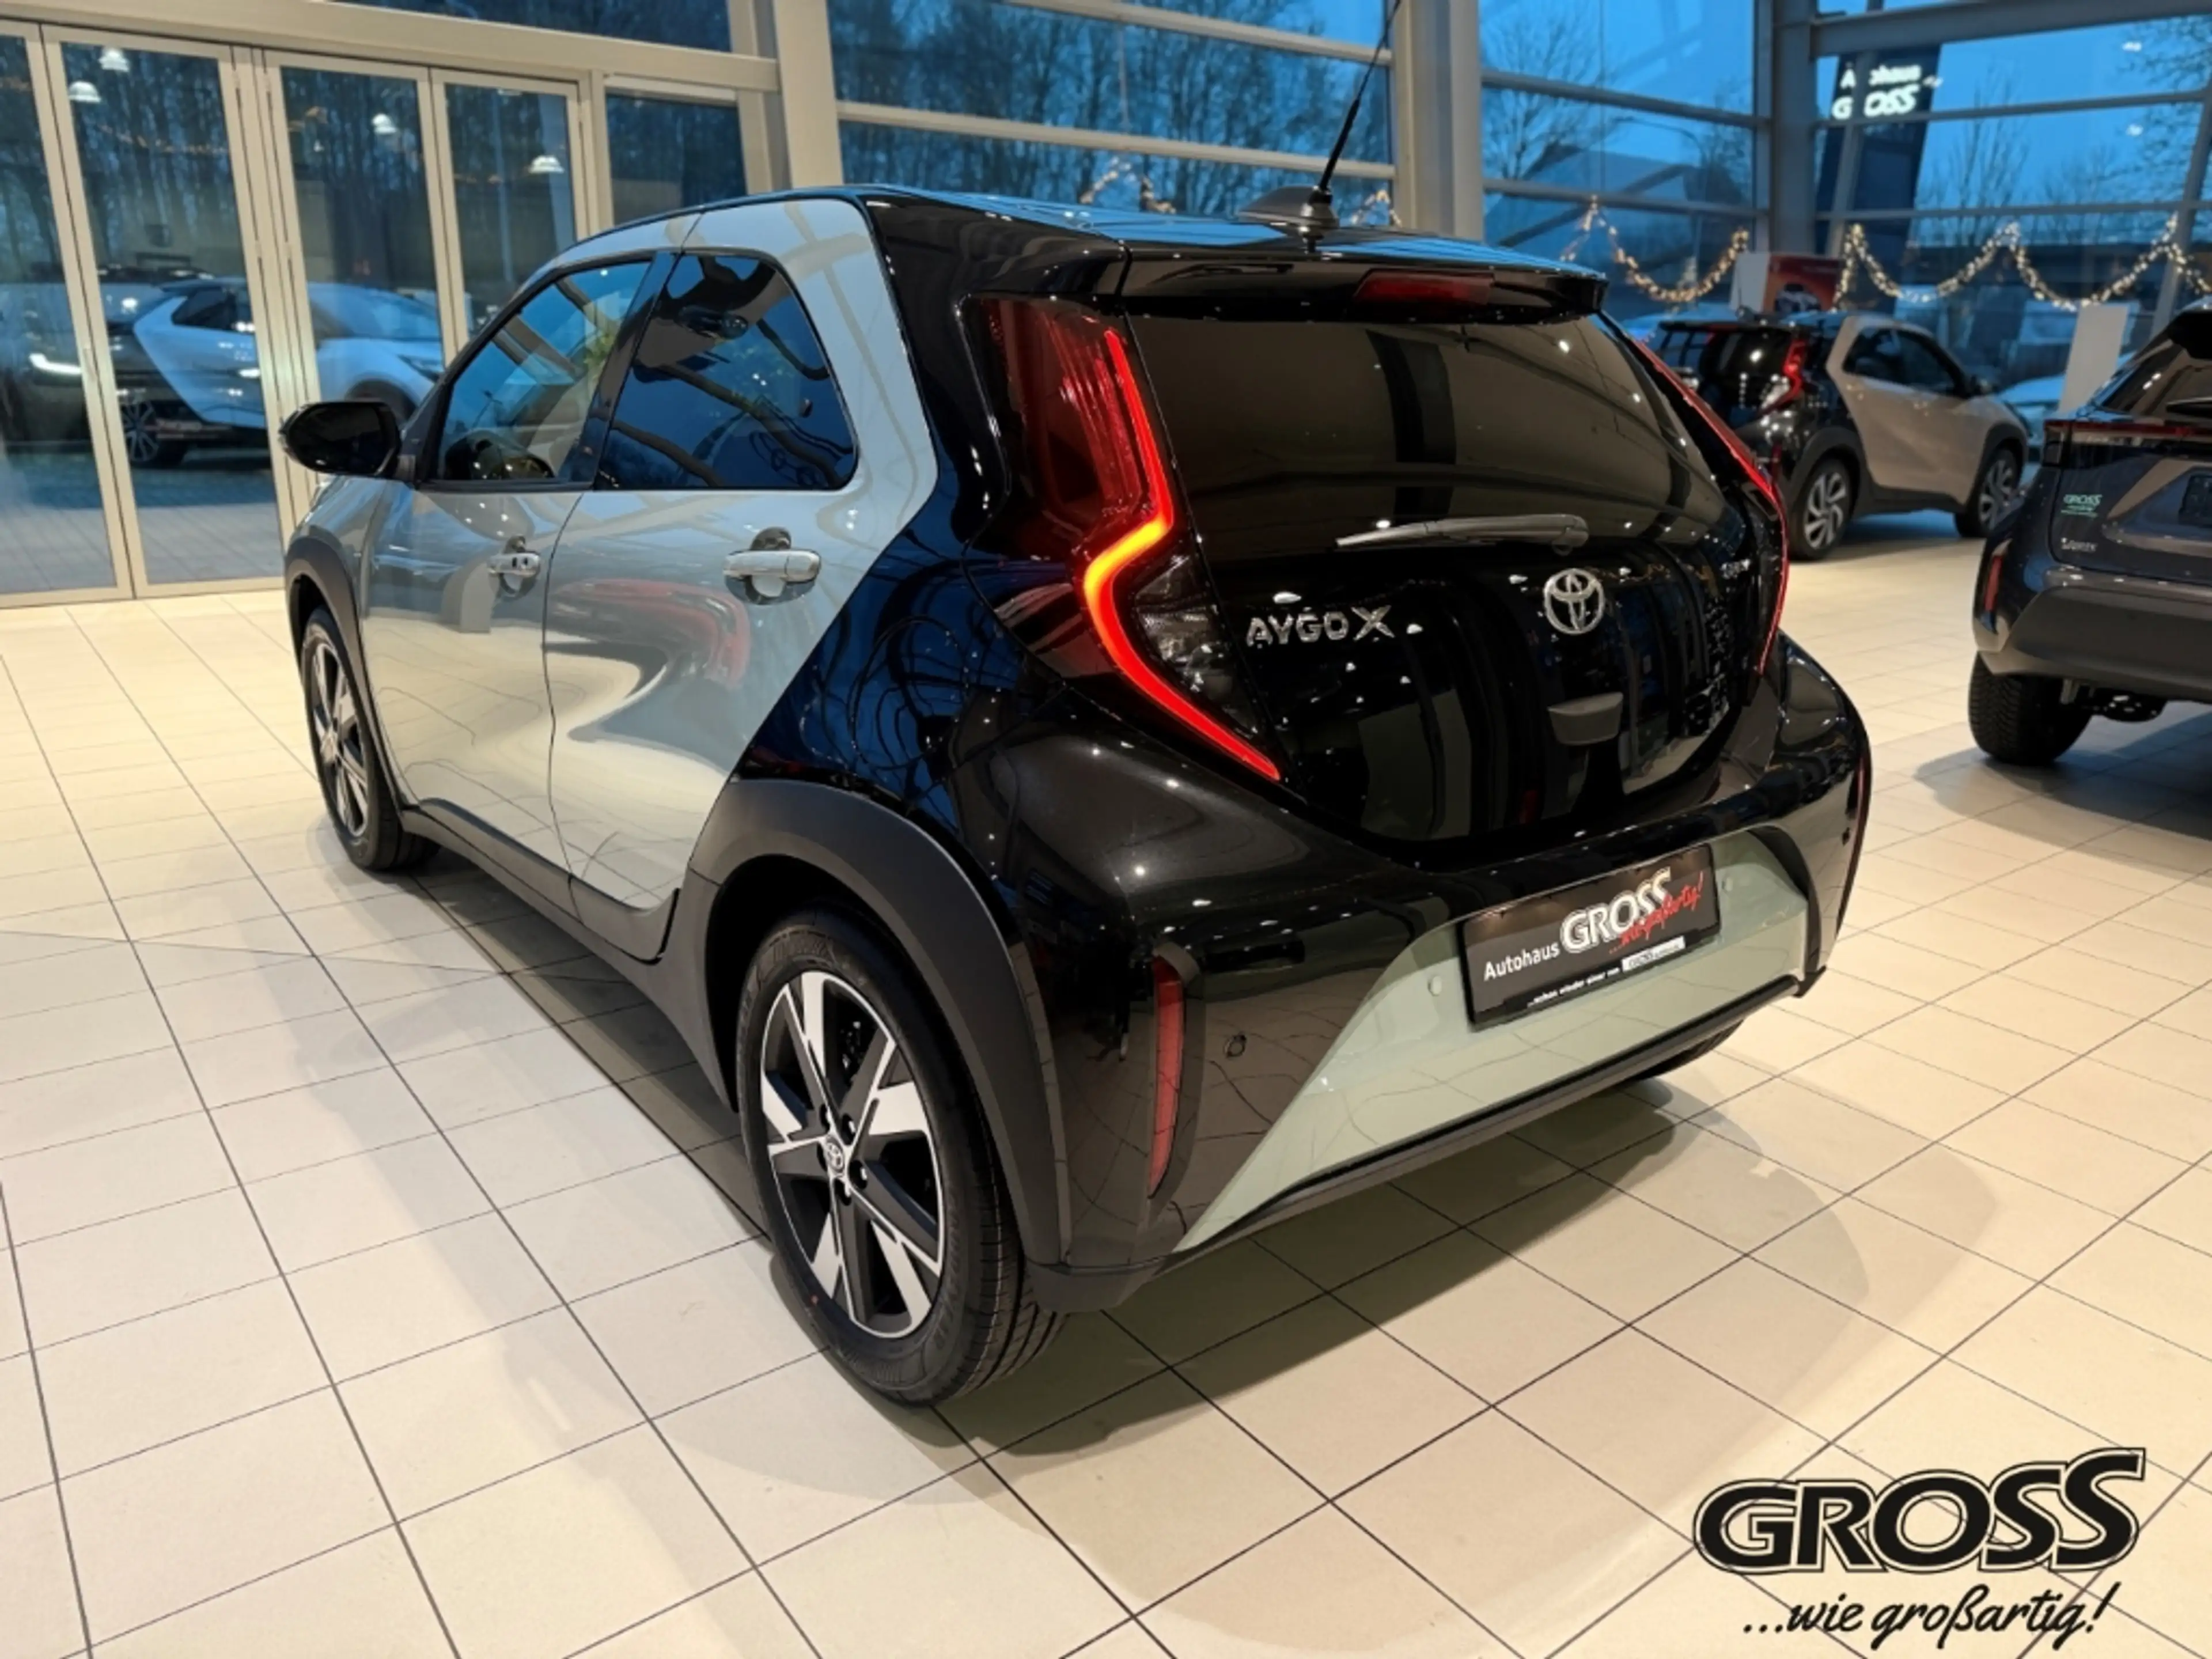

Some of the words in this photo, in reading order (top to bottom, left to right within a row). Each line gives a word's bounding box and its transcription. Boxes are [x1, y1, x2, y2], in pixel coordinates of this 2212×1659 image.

[1831, 84, 1921, 120] GOSS
[1560, 866, 1672, 954] GROSS
[1483, 941, 1560, 982] Autohaus
